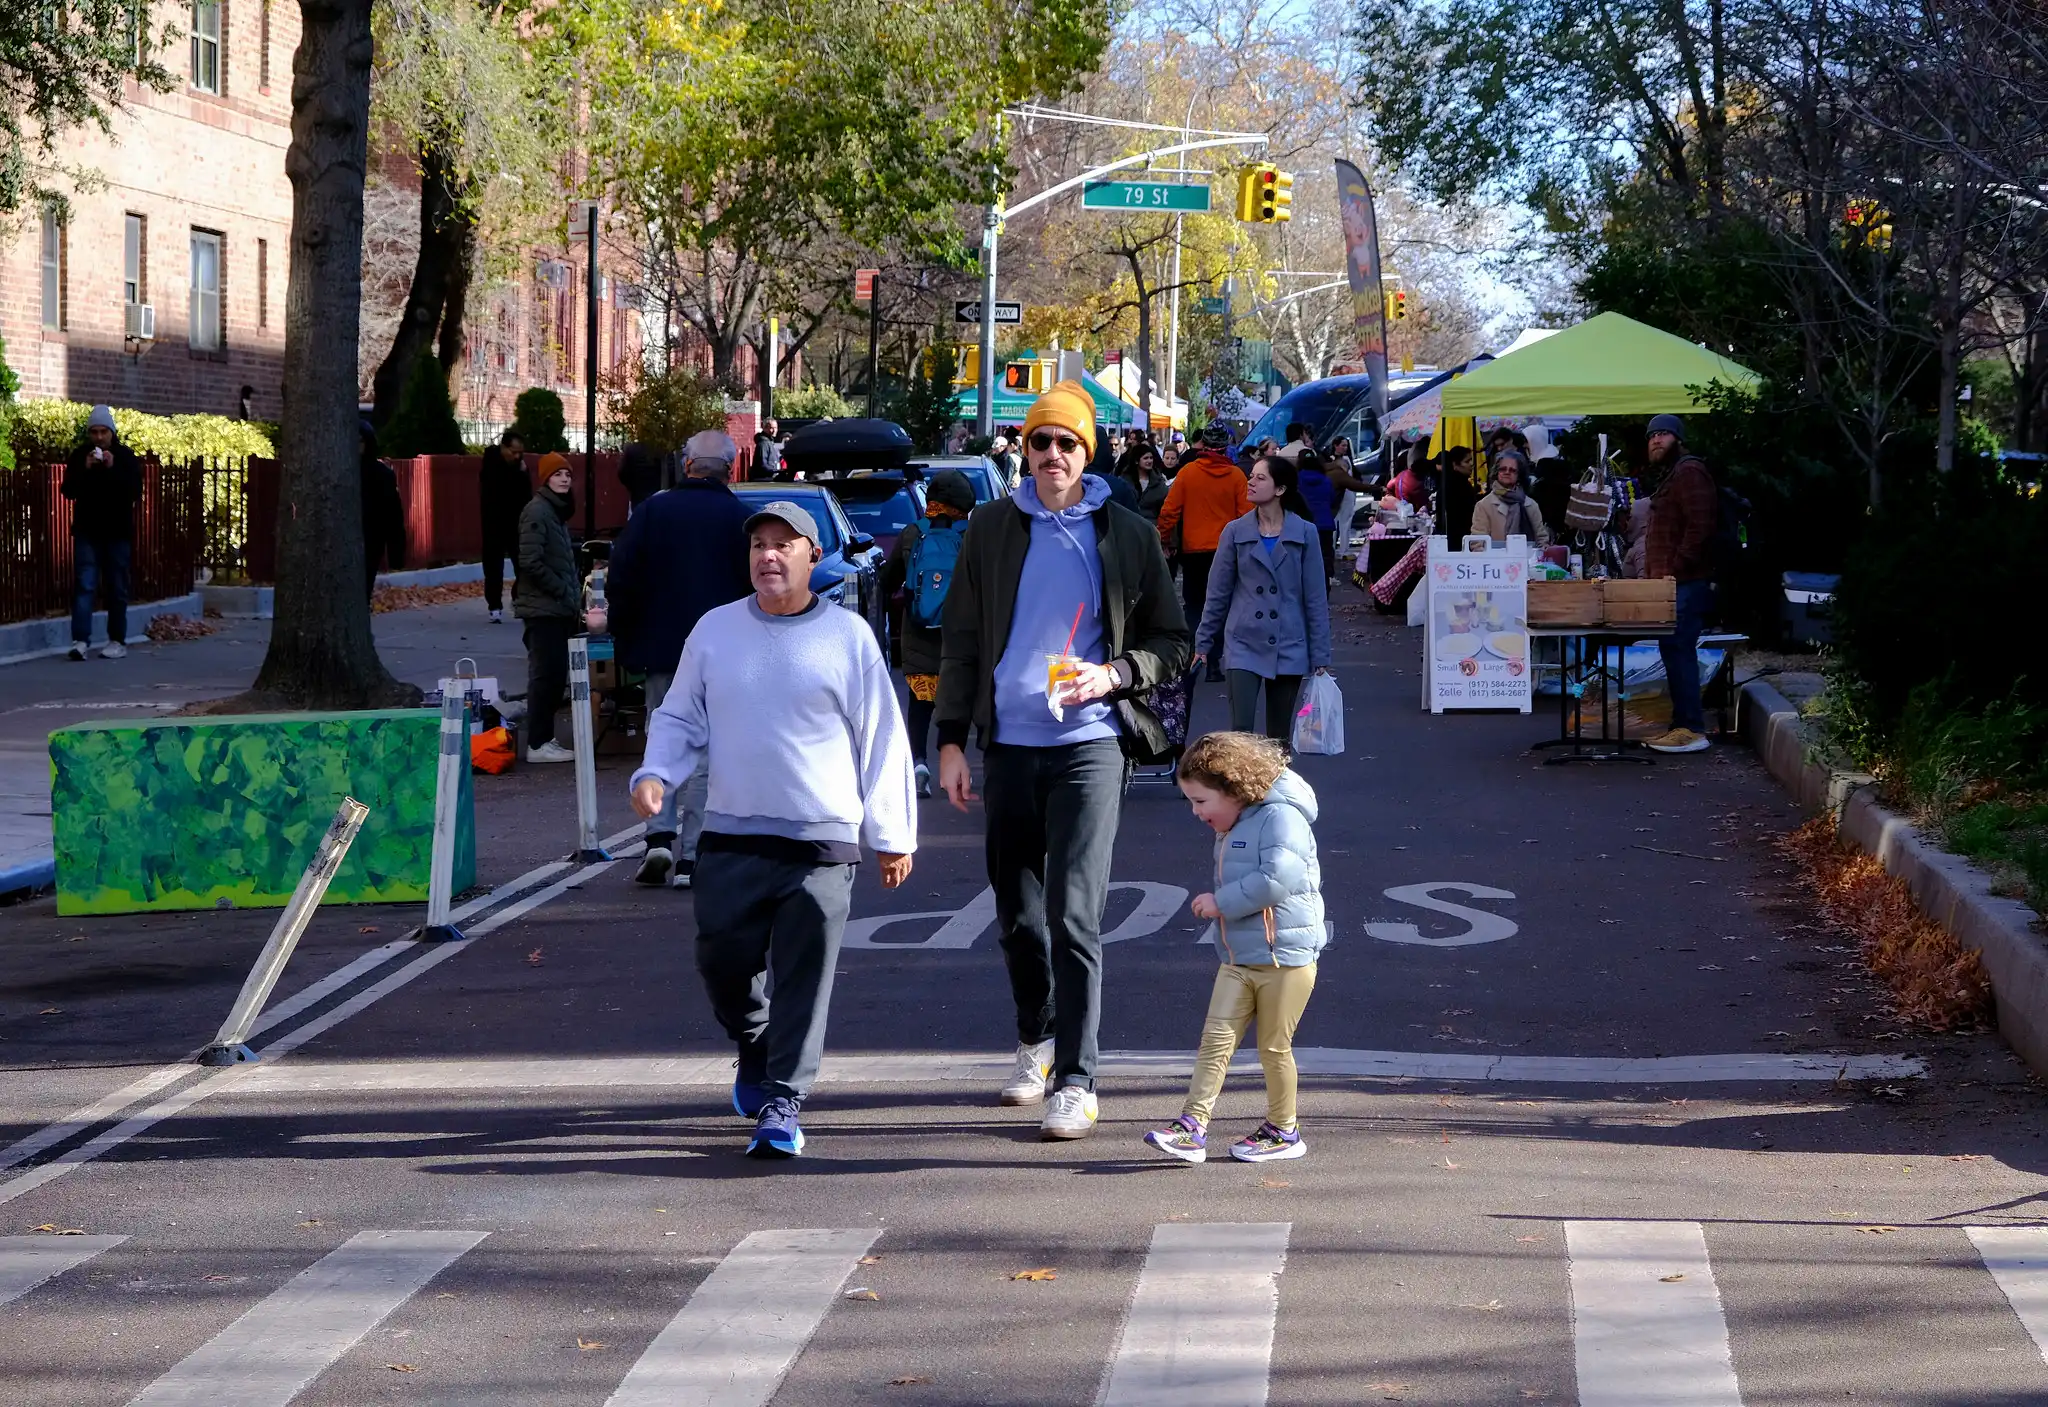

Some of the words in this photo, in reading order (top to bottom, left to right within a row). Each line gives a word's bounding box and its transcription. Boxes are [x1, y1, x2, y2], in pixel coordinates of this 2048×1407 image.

[1124, 187, 1144, 203] 79
[1152, 188, 1169, 205] St
[1482, 563, 1501, 579] Fu
[1437, 663, 1458, 672] Small
[1483, 663, 1504, 673] Large
[1468, 681, 1489, 690] (917)
[1438, 687, 1462, 697] Zelle
[1468, 690, 1489, 699] (917)
